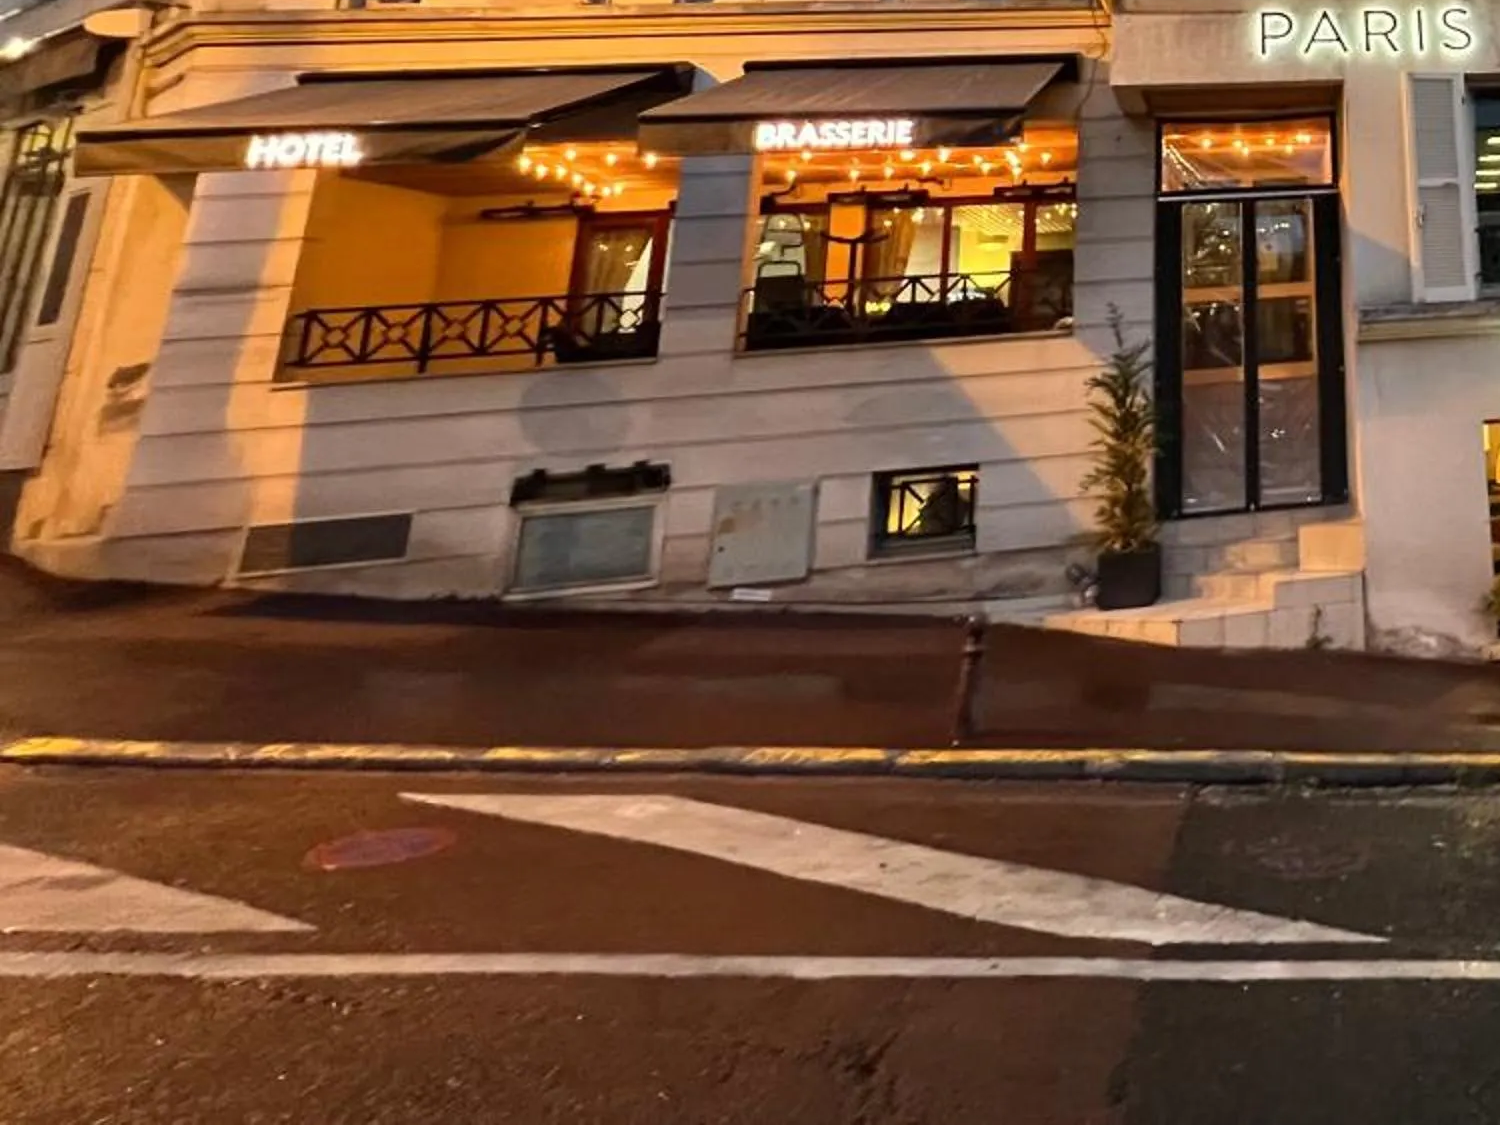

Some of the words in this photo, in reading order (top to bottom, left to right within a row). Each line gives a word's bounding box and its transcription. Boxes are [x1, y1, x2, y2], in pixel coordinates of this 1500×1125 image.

[1260, 7, 1472, 55] PARIS
[245, 130, 365, 170] HOTEL
[755, 119, 914, 151] BRASSERIE
